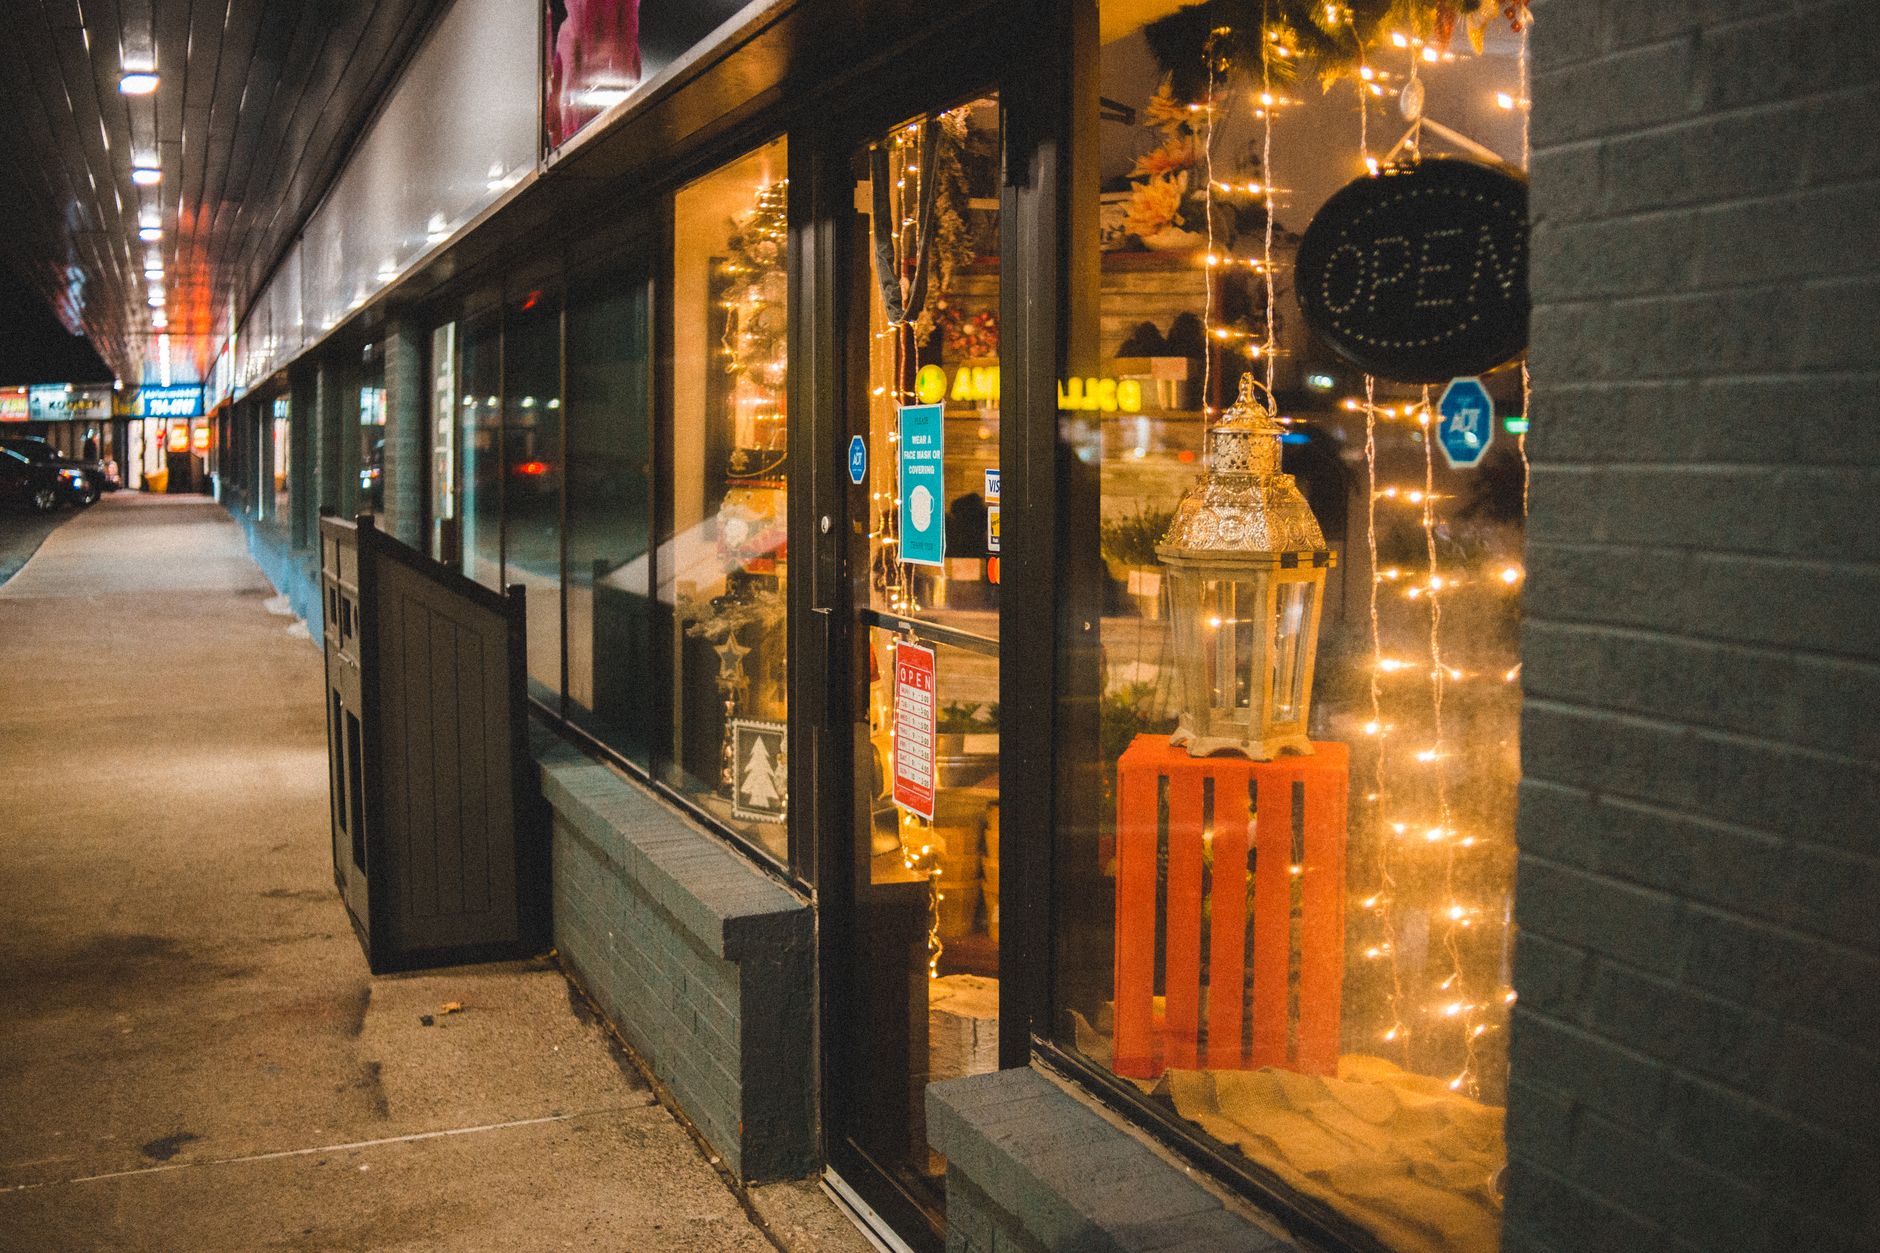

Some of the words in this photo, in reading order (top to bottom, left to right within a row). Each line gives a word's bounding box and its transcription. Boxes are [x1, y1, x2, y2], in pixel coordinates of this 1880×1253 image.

[1322, 225, 1522, 313] OPEN
[1449, 408, 1481, 433] ADT
[911, 435, 927, 445] WEAR
[927, 435, 932, 444] A
[903, 450, 916, 460] FACE
[916, 450, 931, 460] MASK
[932, 450, 941, 460] OR
[908, 465, 935, 475] COVERING
[988, 479, 1000, 493] VIS
[900, 667, 931, 690] OPEN
